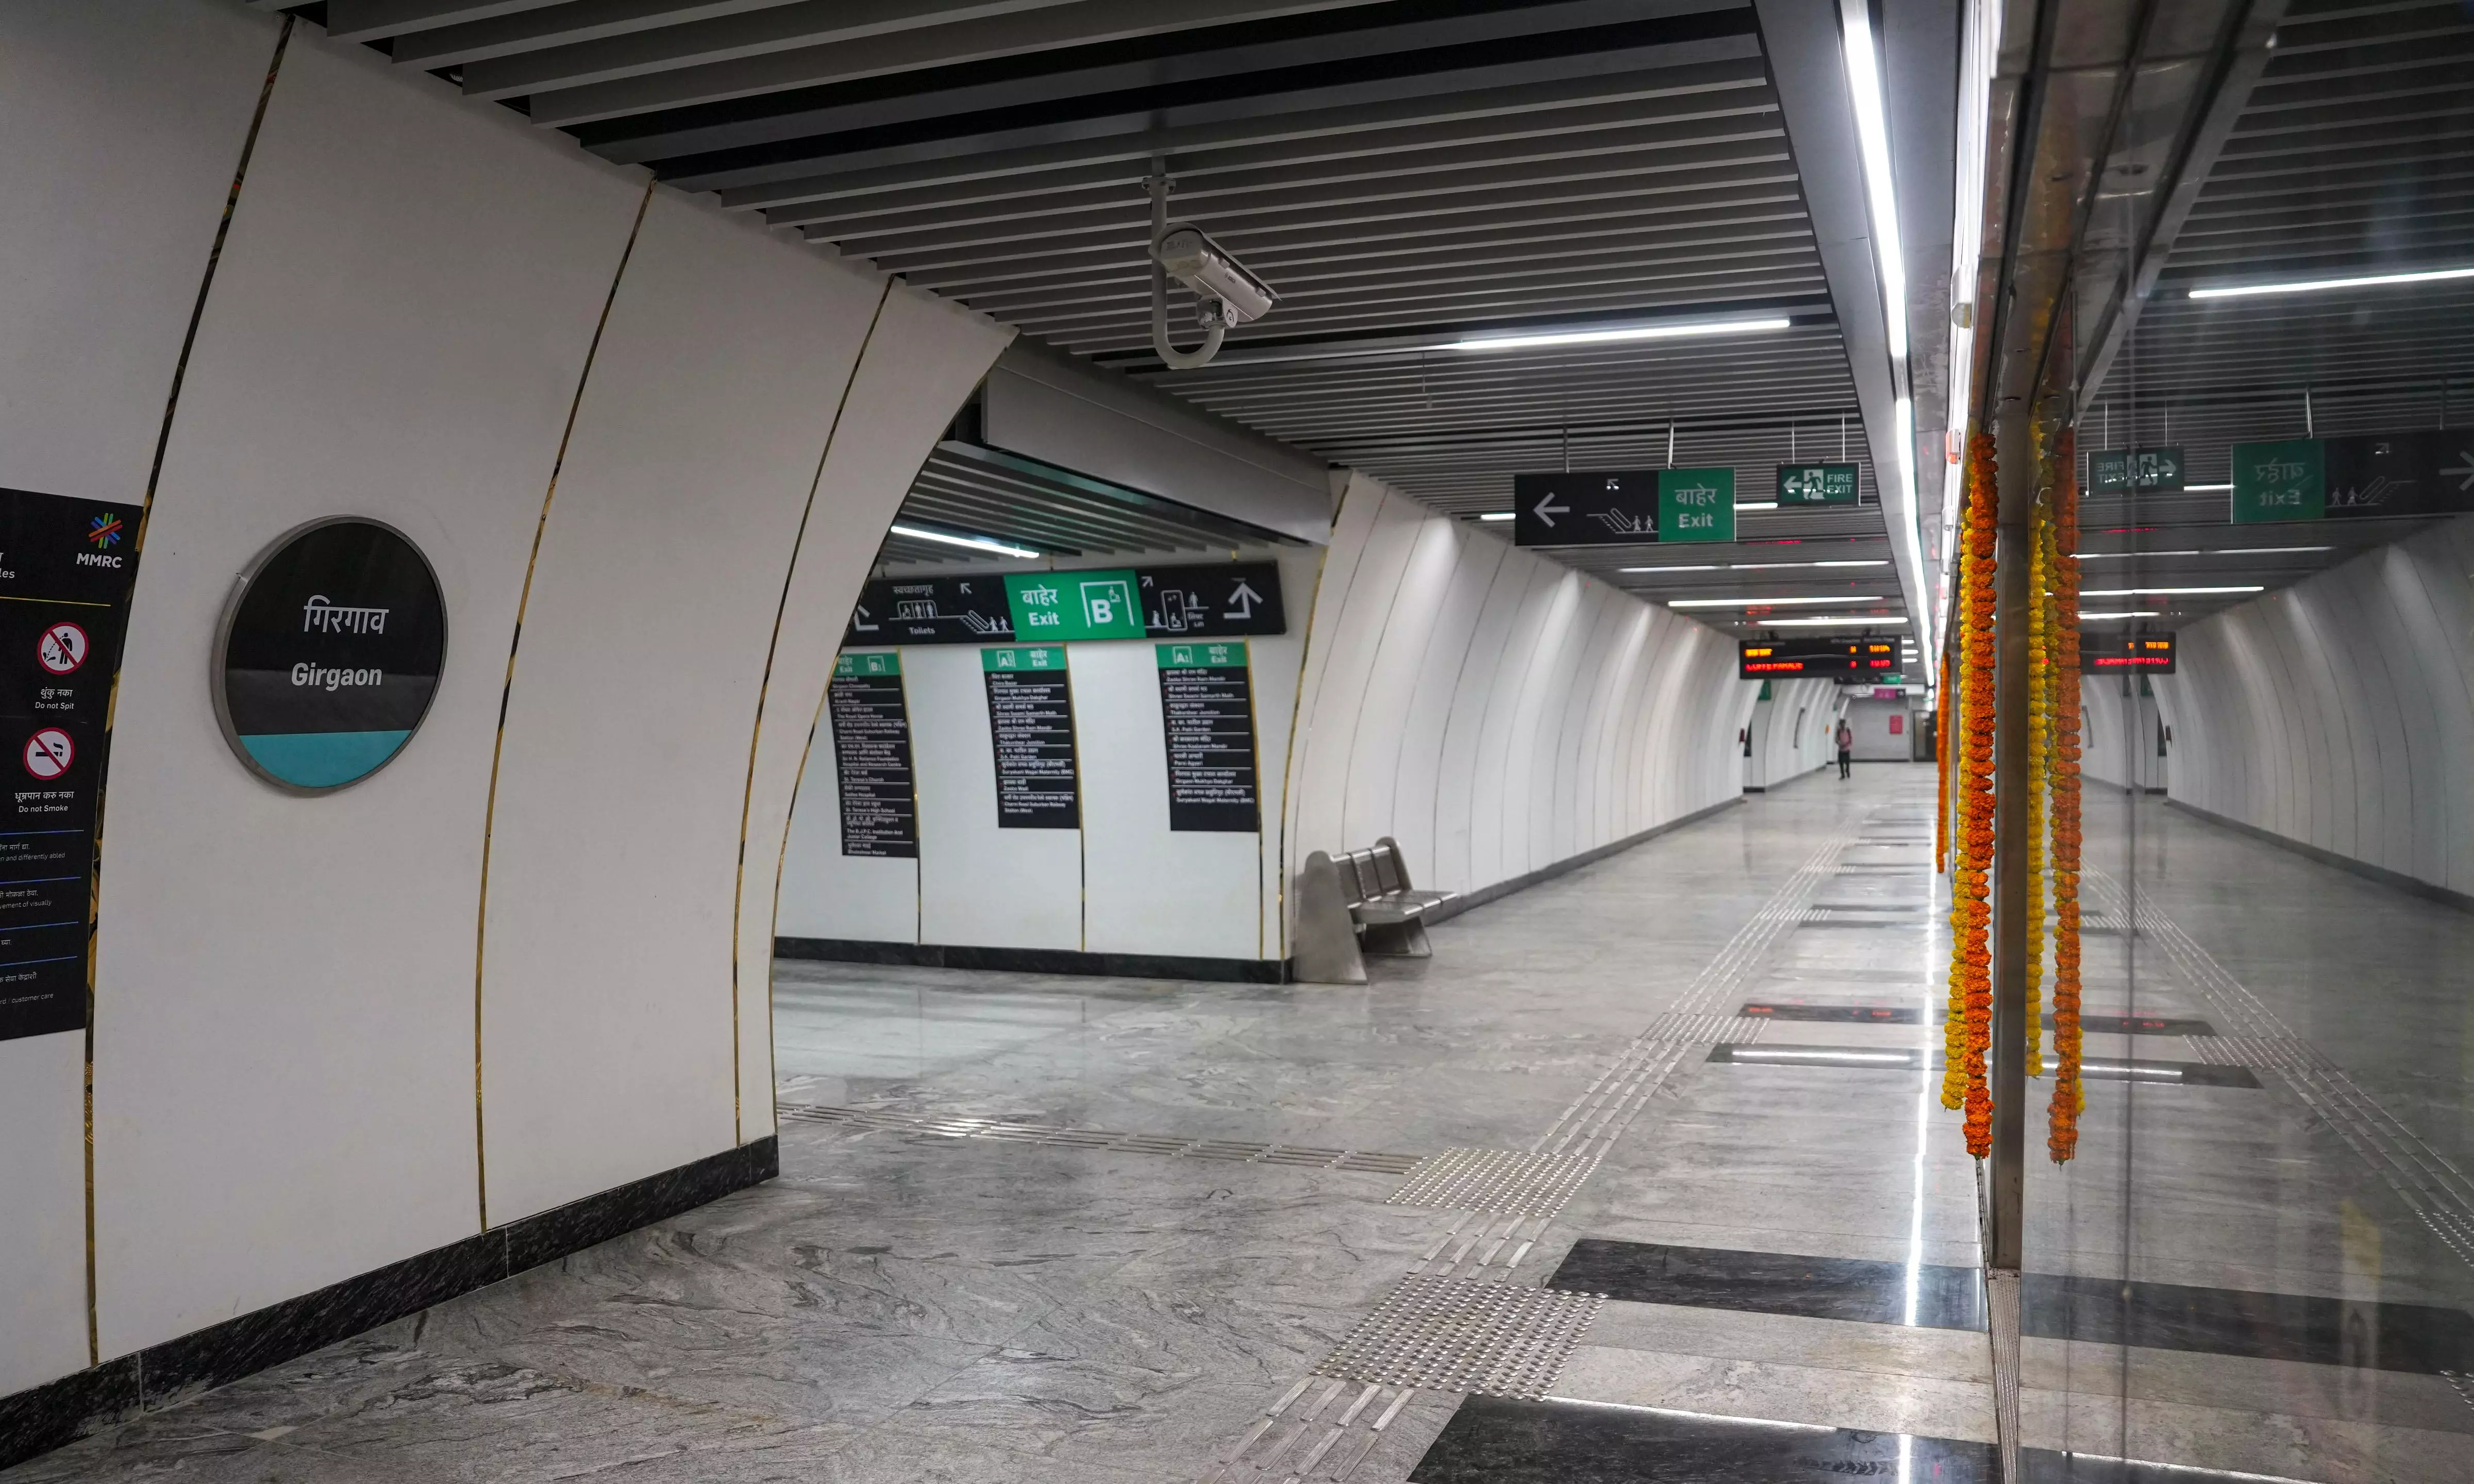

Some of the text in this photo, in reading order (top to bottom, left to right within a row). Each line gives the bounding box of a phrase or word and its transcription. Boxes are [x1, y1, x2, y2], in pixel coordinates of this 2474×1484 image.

[1827, 474, 1853, 482] FIRE
[1675, 483, 1717, 505] बाहेर
[1827, 484, 1853, 494] EXIT
[1679, 513, 1713, 528] Exit
[76, 552, 122, 568] MMRC
[1021, 584, 1058, 605] बाहेर
[304, 595, 389, 635] गिरगाव
[1091, 599, 1113, 623] B
[1028, 612, 1060, 626] Exit
[291, 662, 382, 691] Girgaon
[60, 702, 74, 710] Spit
[12, 995, 40, 1004] customer
